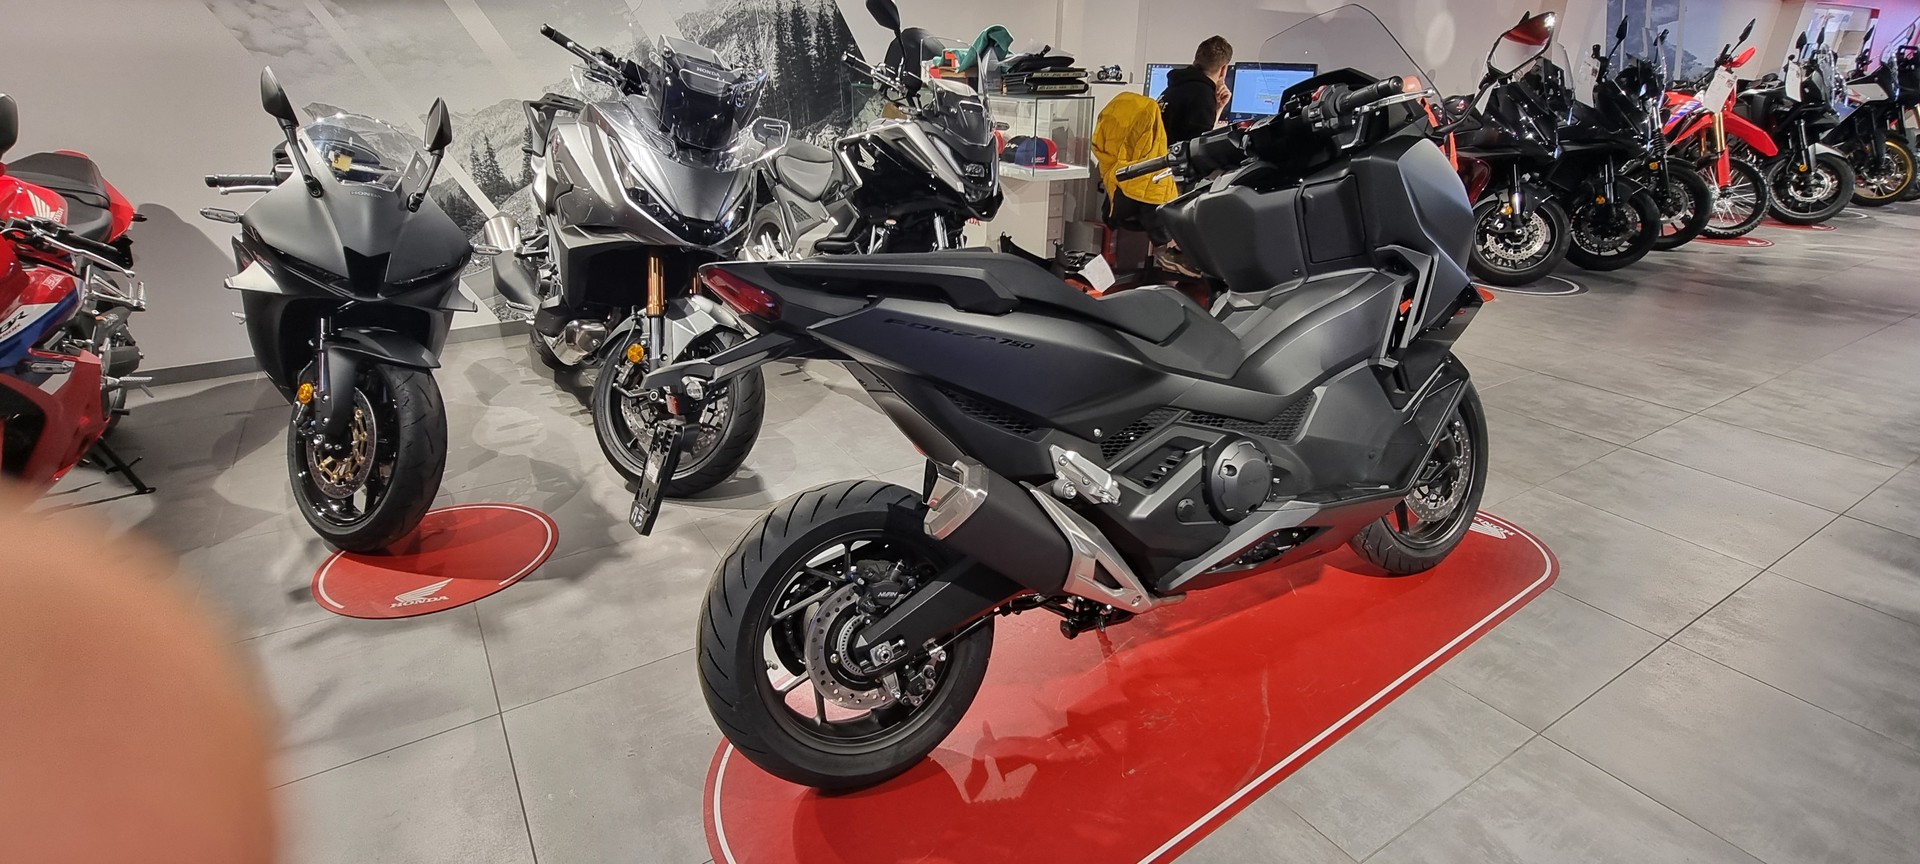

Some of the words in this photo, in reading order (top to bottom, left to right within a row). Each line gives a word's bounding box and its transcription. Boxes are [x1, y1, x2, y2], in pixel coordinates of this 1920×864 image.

[697, 66, 721, 78] HONDA
[350, 191, 383, 199] HONDA
[884, 318, 996, 341] FORZA
[998, 337, 1035, 350] 750
[1473, 516, 1515, 536] HOND
[389, 595, 450, 608] HONDA
